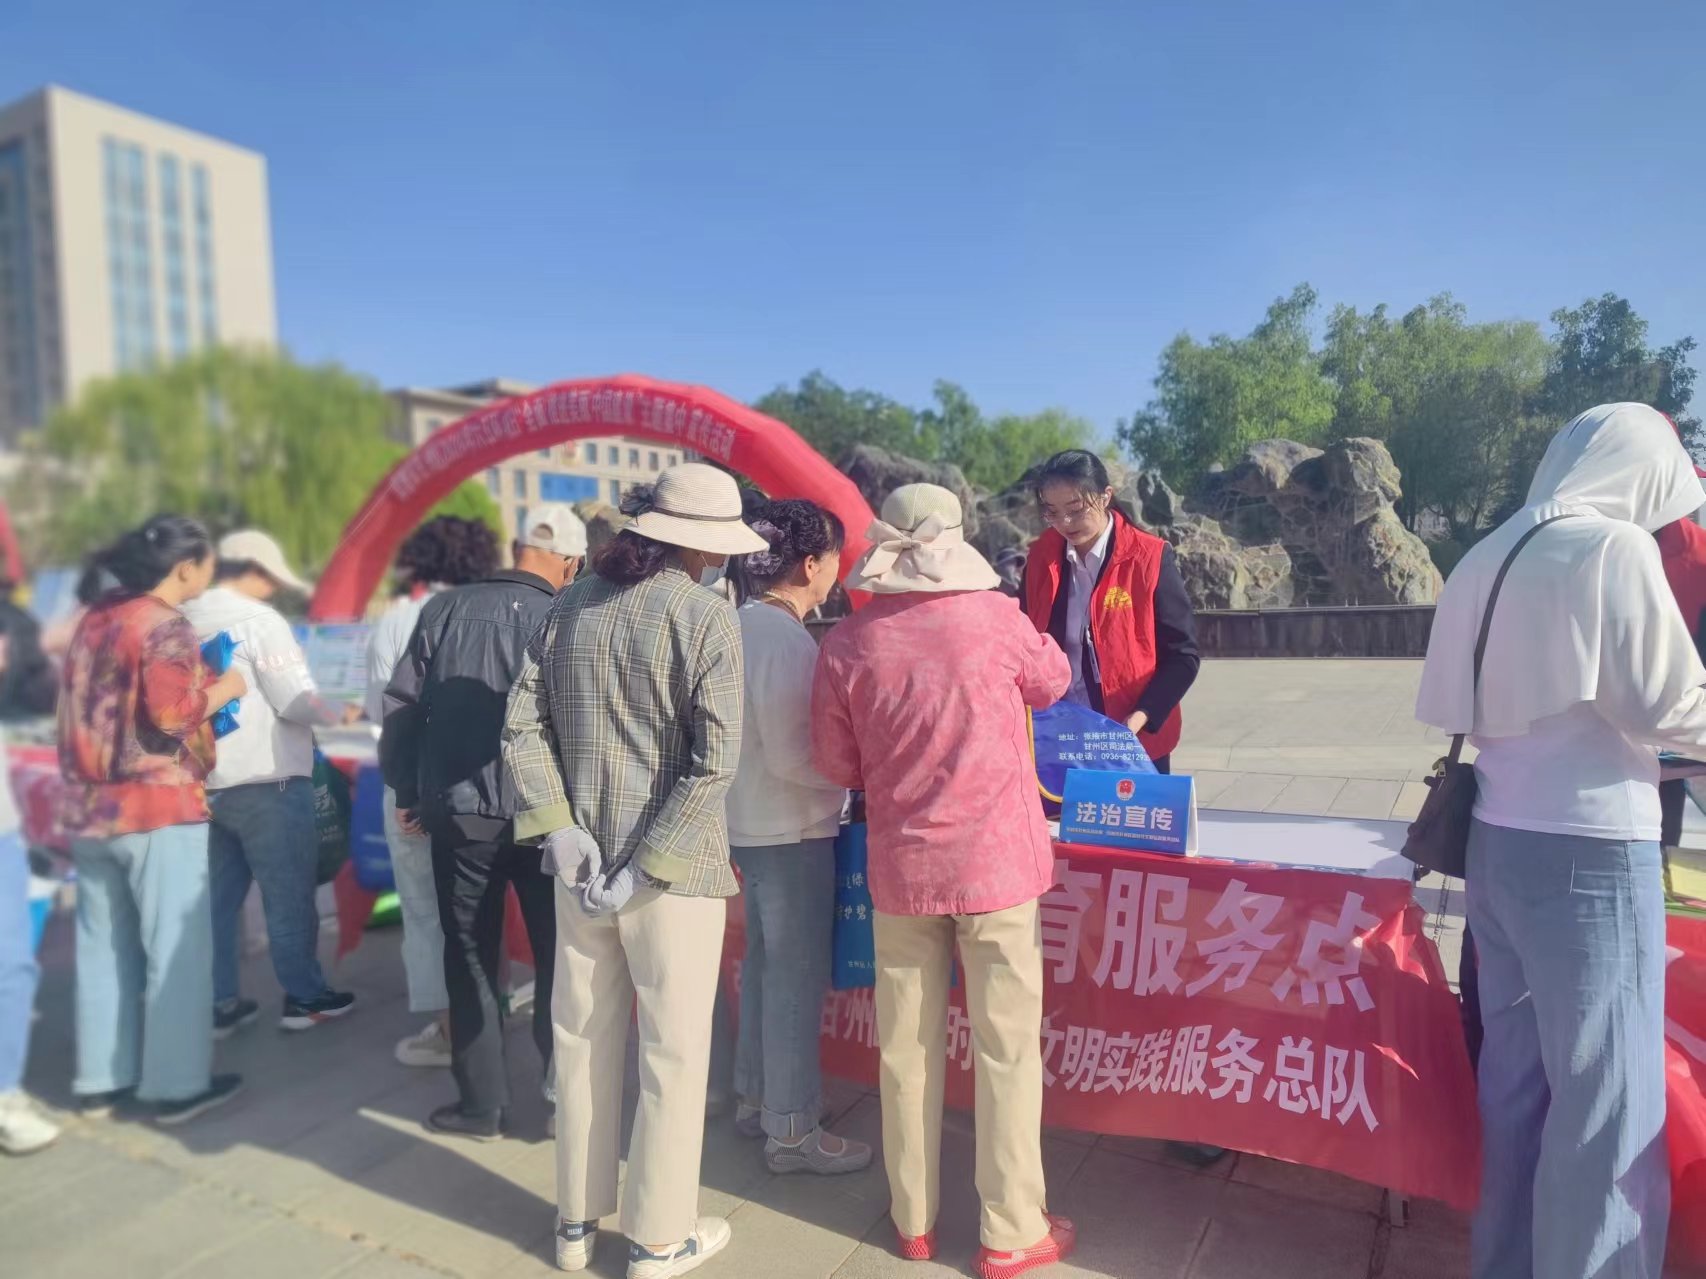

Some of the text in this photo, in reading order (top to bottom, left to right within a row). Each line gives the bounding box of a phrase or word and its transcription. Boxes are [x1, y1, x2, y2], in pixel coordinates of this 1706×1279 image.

[1075, 802, 1173, 831] 法治宣传
[1040, 859, 1383, 1012] 育服务点
